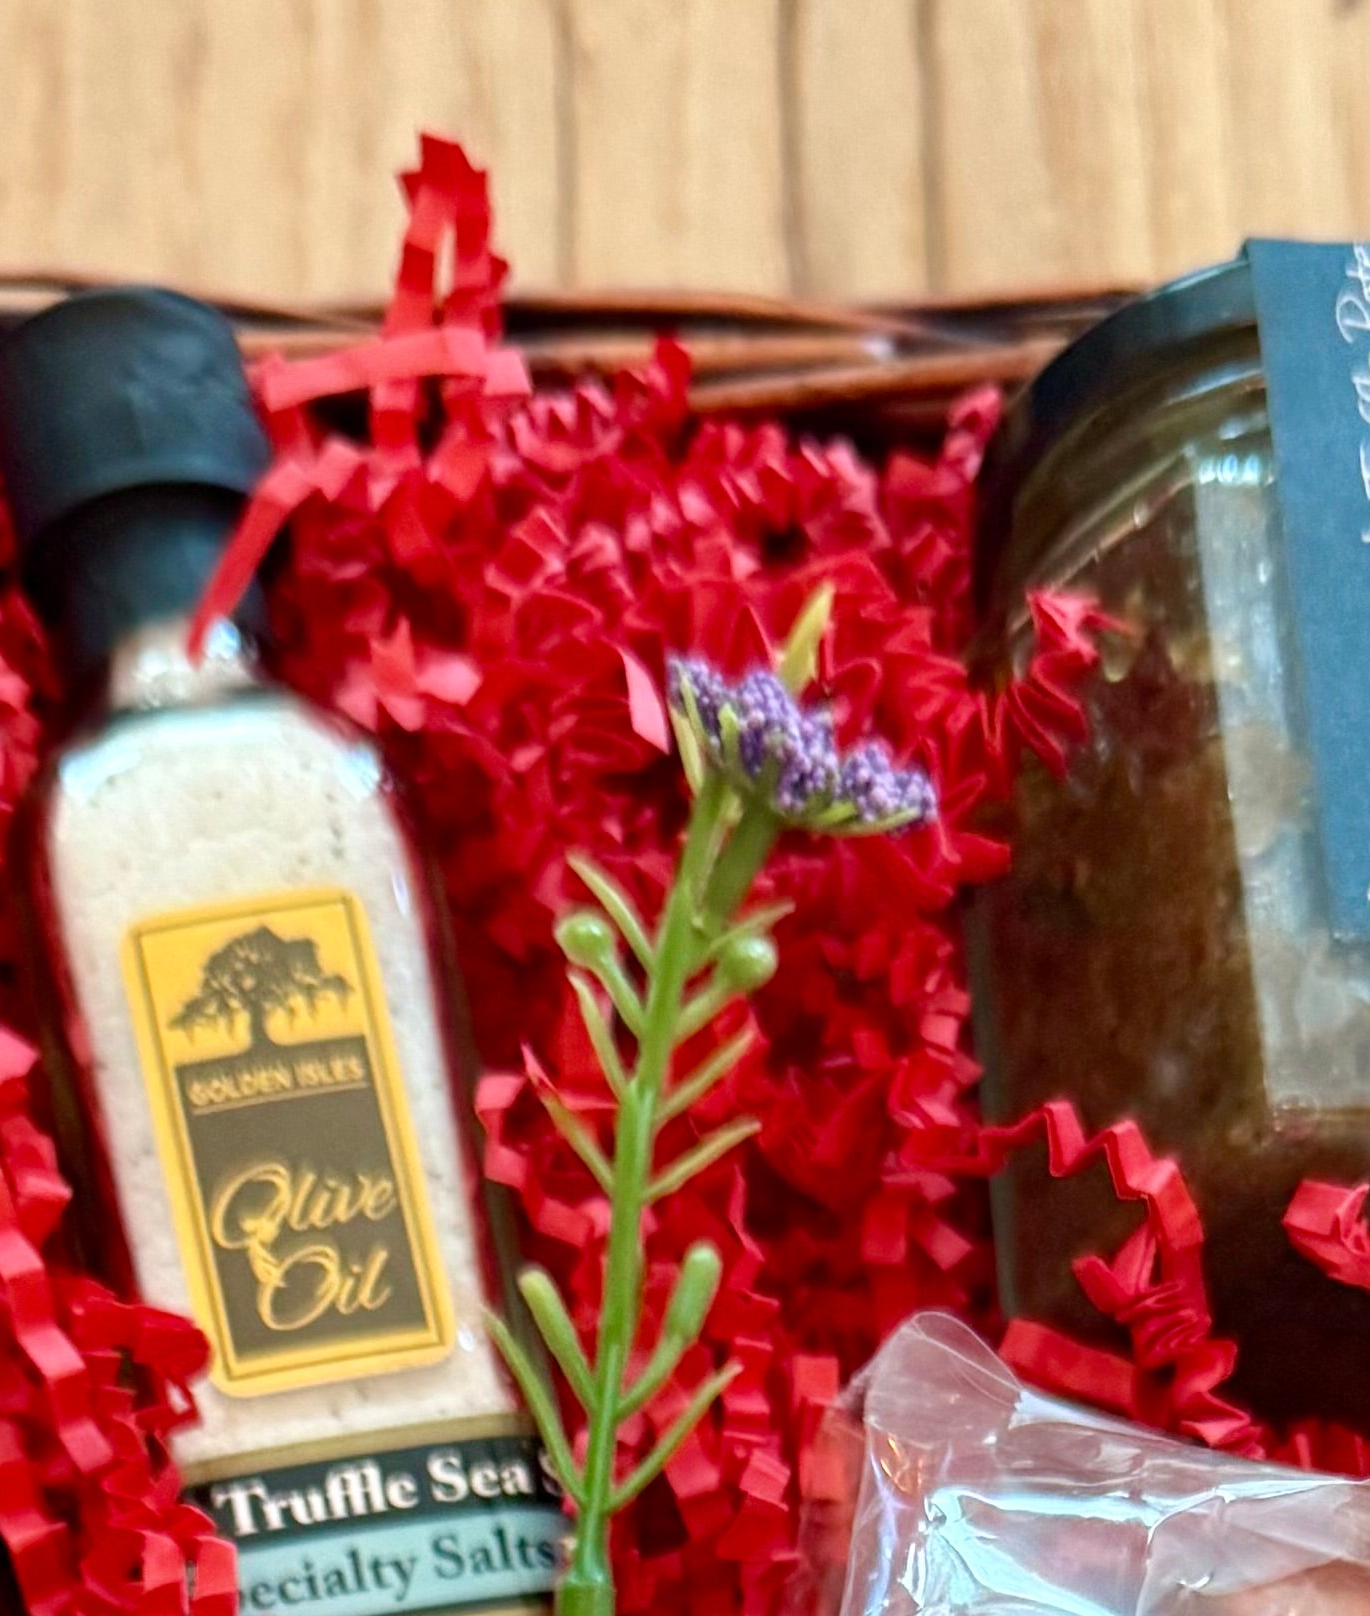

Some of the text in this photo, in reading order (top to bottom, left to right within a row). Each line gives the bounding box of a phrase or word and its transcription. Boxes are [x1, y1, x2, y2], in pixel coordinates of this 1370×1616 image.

[187, 1055, 364, 1107] GOLDEN ISLES
[212, 1162, 397, 1250] Olive
[257, 1244, 391, 1331] Oil
[211, 1466, 420, 1537] Truffle
[427, 1446, 534, 1502] Sea
[238, 1520, 557, 1611] ecialty Salts
